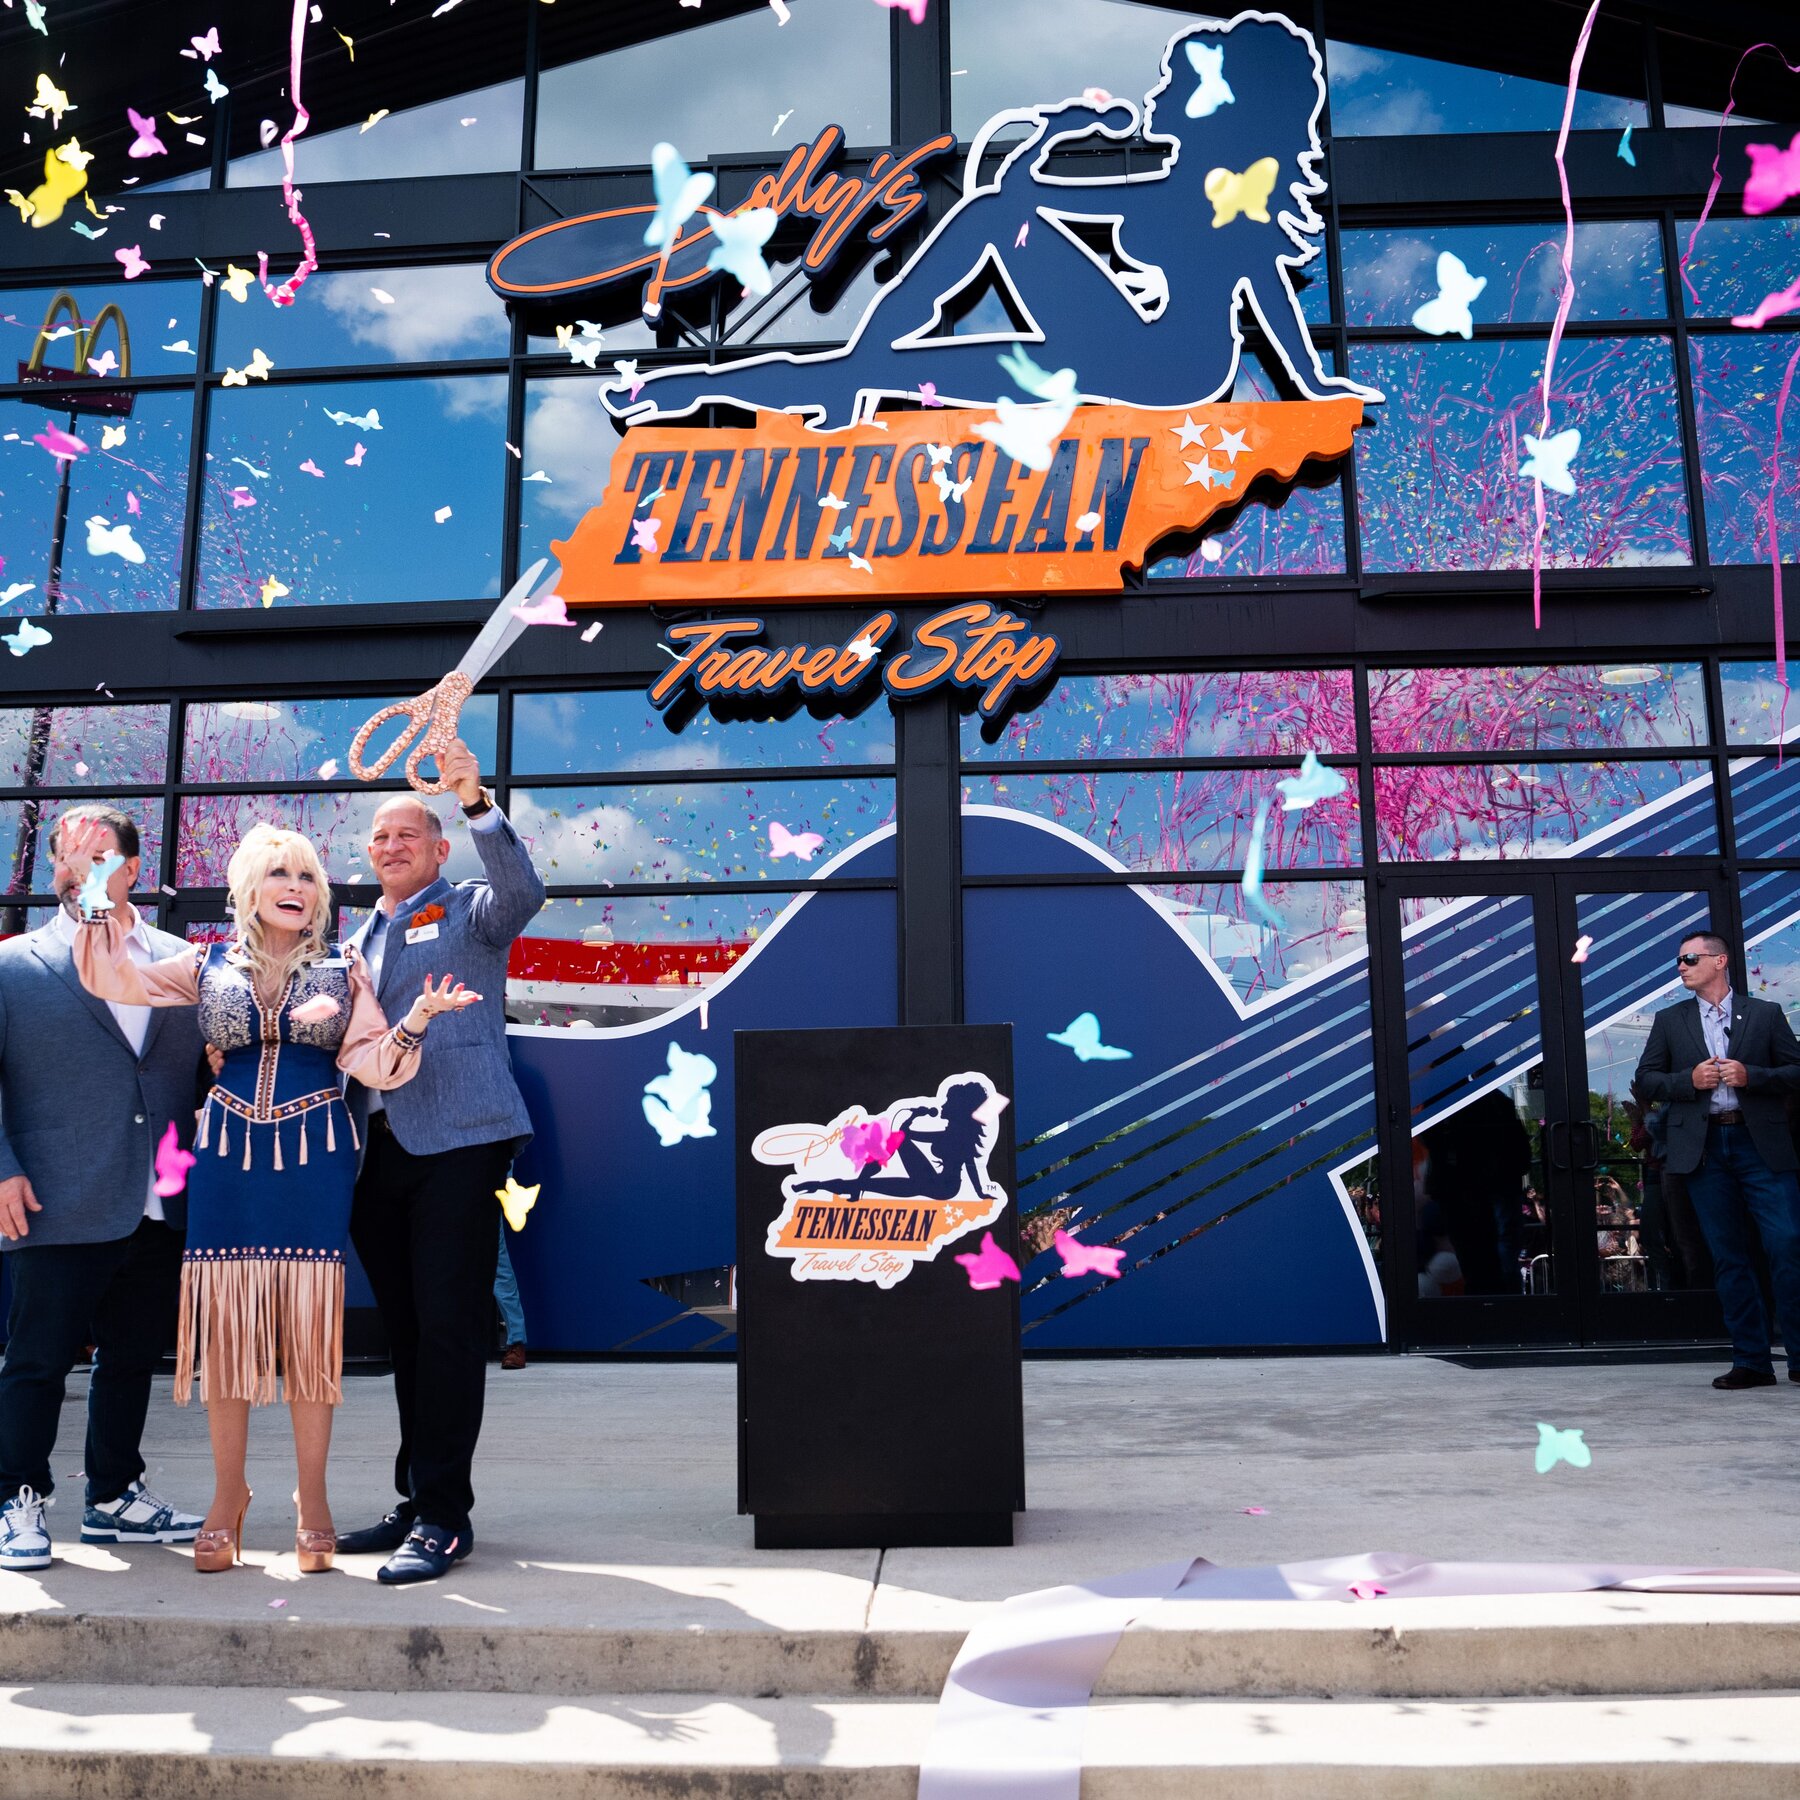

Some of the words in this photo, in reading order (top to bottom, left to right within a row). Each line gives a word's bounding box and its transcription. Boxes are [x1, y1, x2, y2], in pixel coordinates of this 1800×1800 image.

[490, 124, 956, 312] Dolly's
[614, 437, 1150, 564] TENNESSEAN
[652, 610, 895, 701] Travel
[887, 602, 1057, 712] Stop
[794, 1206, 937, 1242] TENNESSEAN
[799, 1252, 861, 1272] Travel
[861, 1251, 905, 1280] Stop
